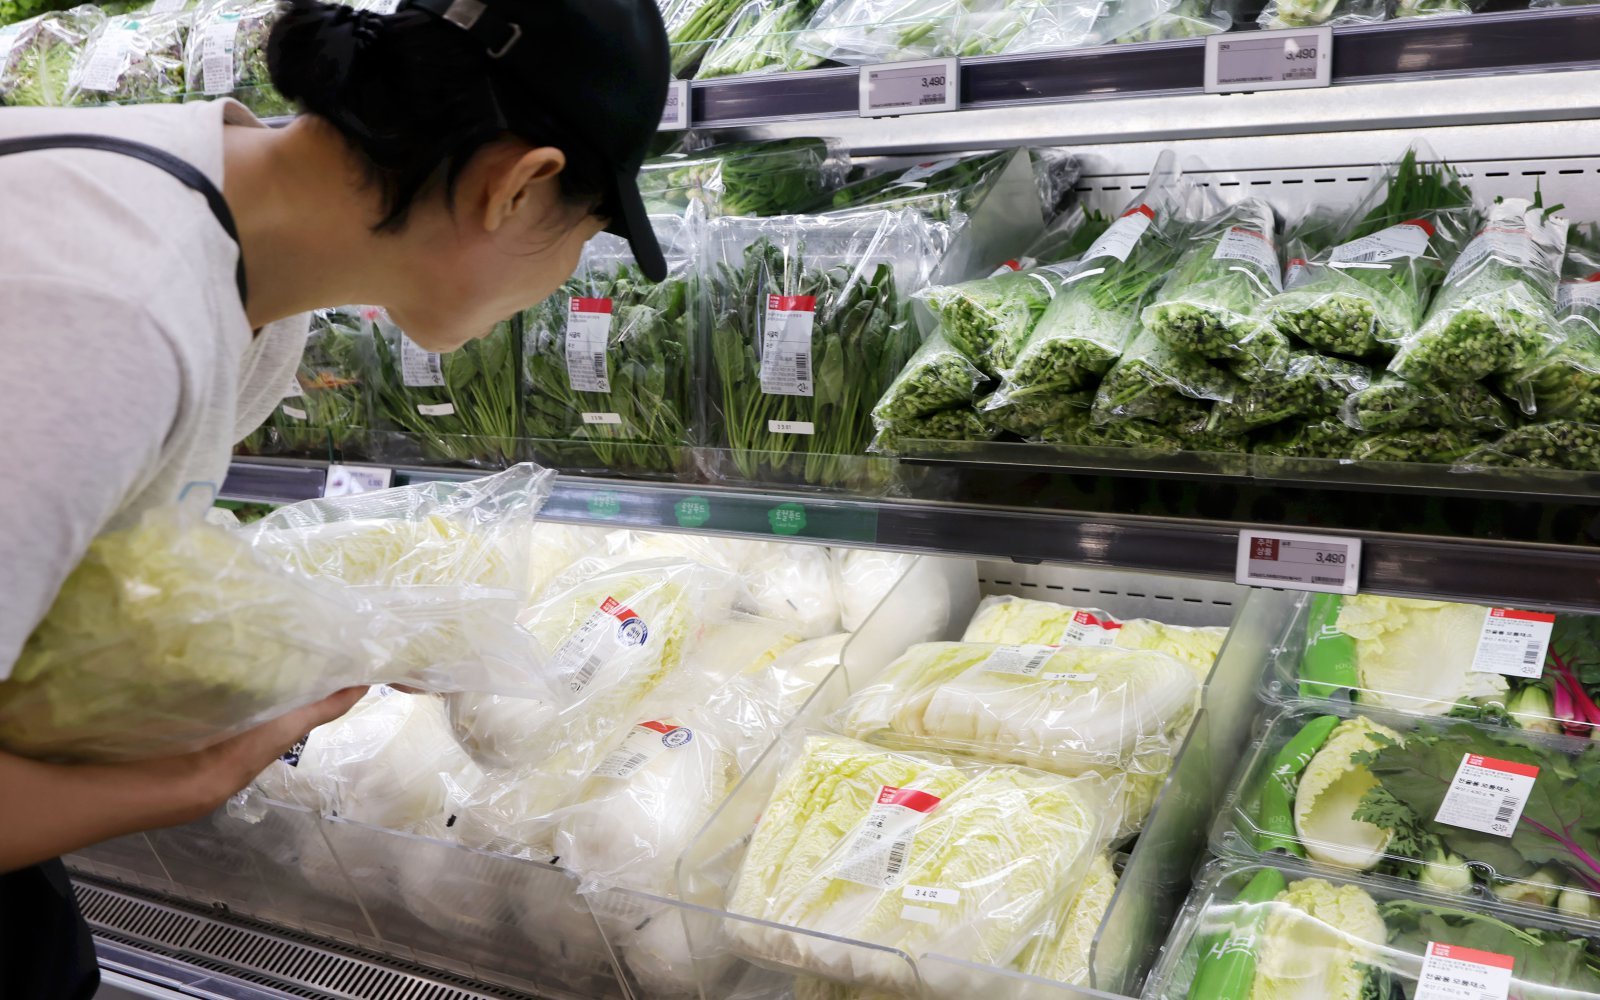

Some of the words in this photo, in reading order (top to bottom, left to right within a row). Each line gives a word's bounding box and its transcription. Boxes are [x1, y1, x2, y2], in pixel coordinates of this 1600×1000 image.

[1286, 48, 1317, 61] 3,490
[921, 76, 946, 88] 3,490
[681, 502, 705, 515] 로컬푸드
[776, 509, 801, 522] 로컬푸드
[1256, 547, 1272, 556] 상품
[1315, 552, 1346, 564] 3,490
